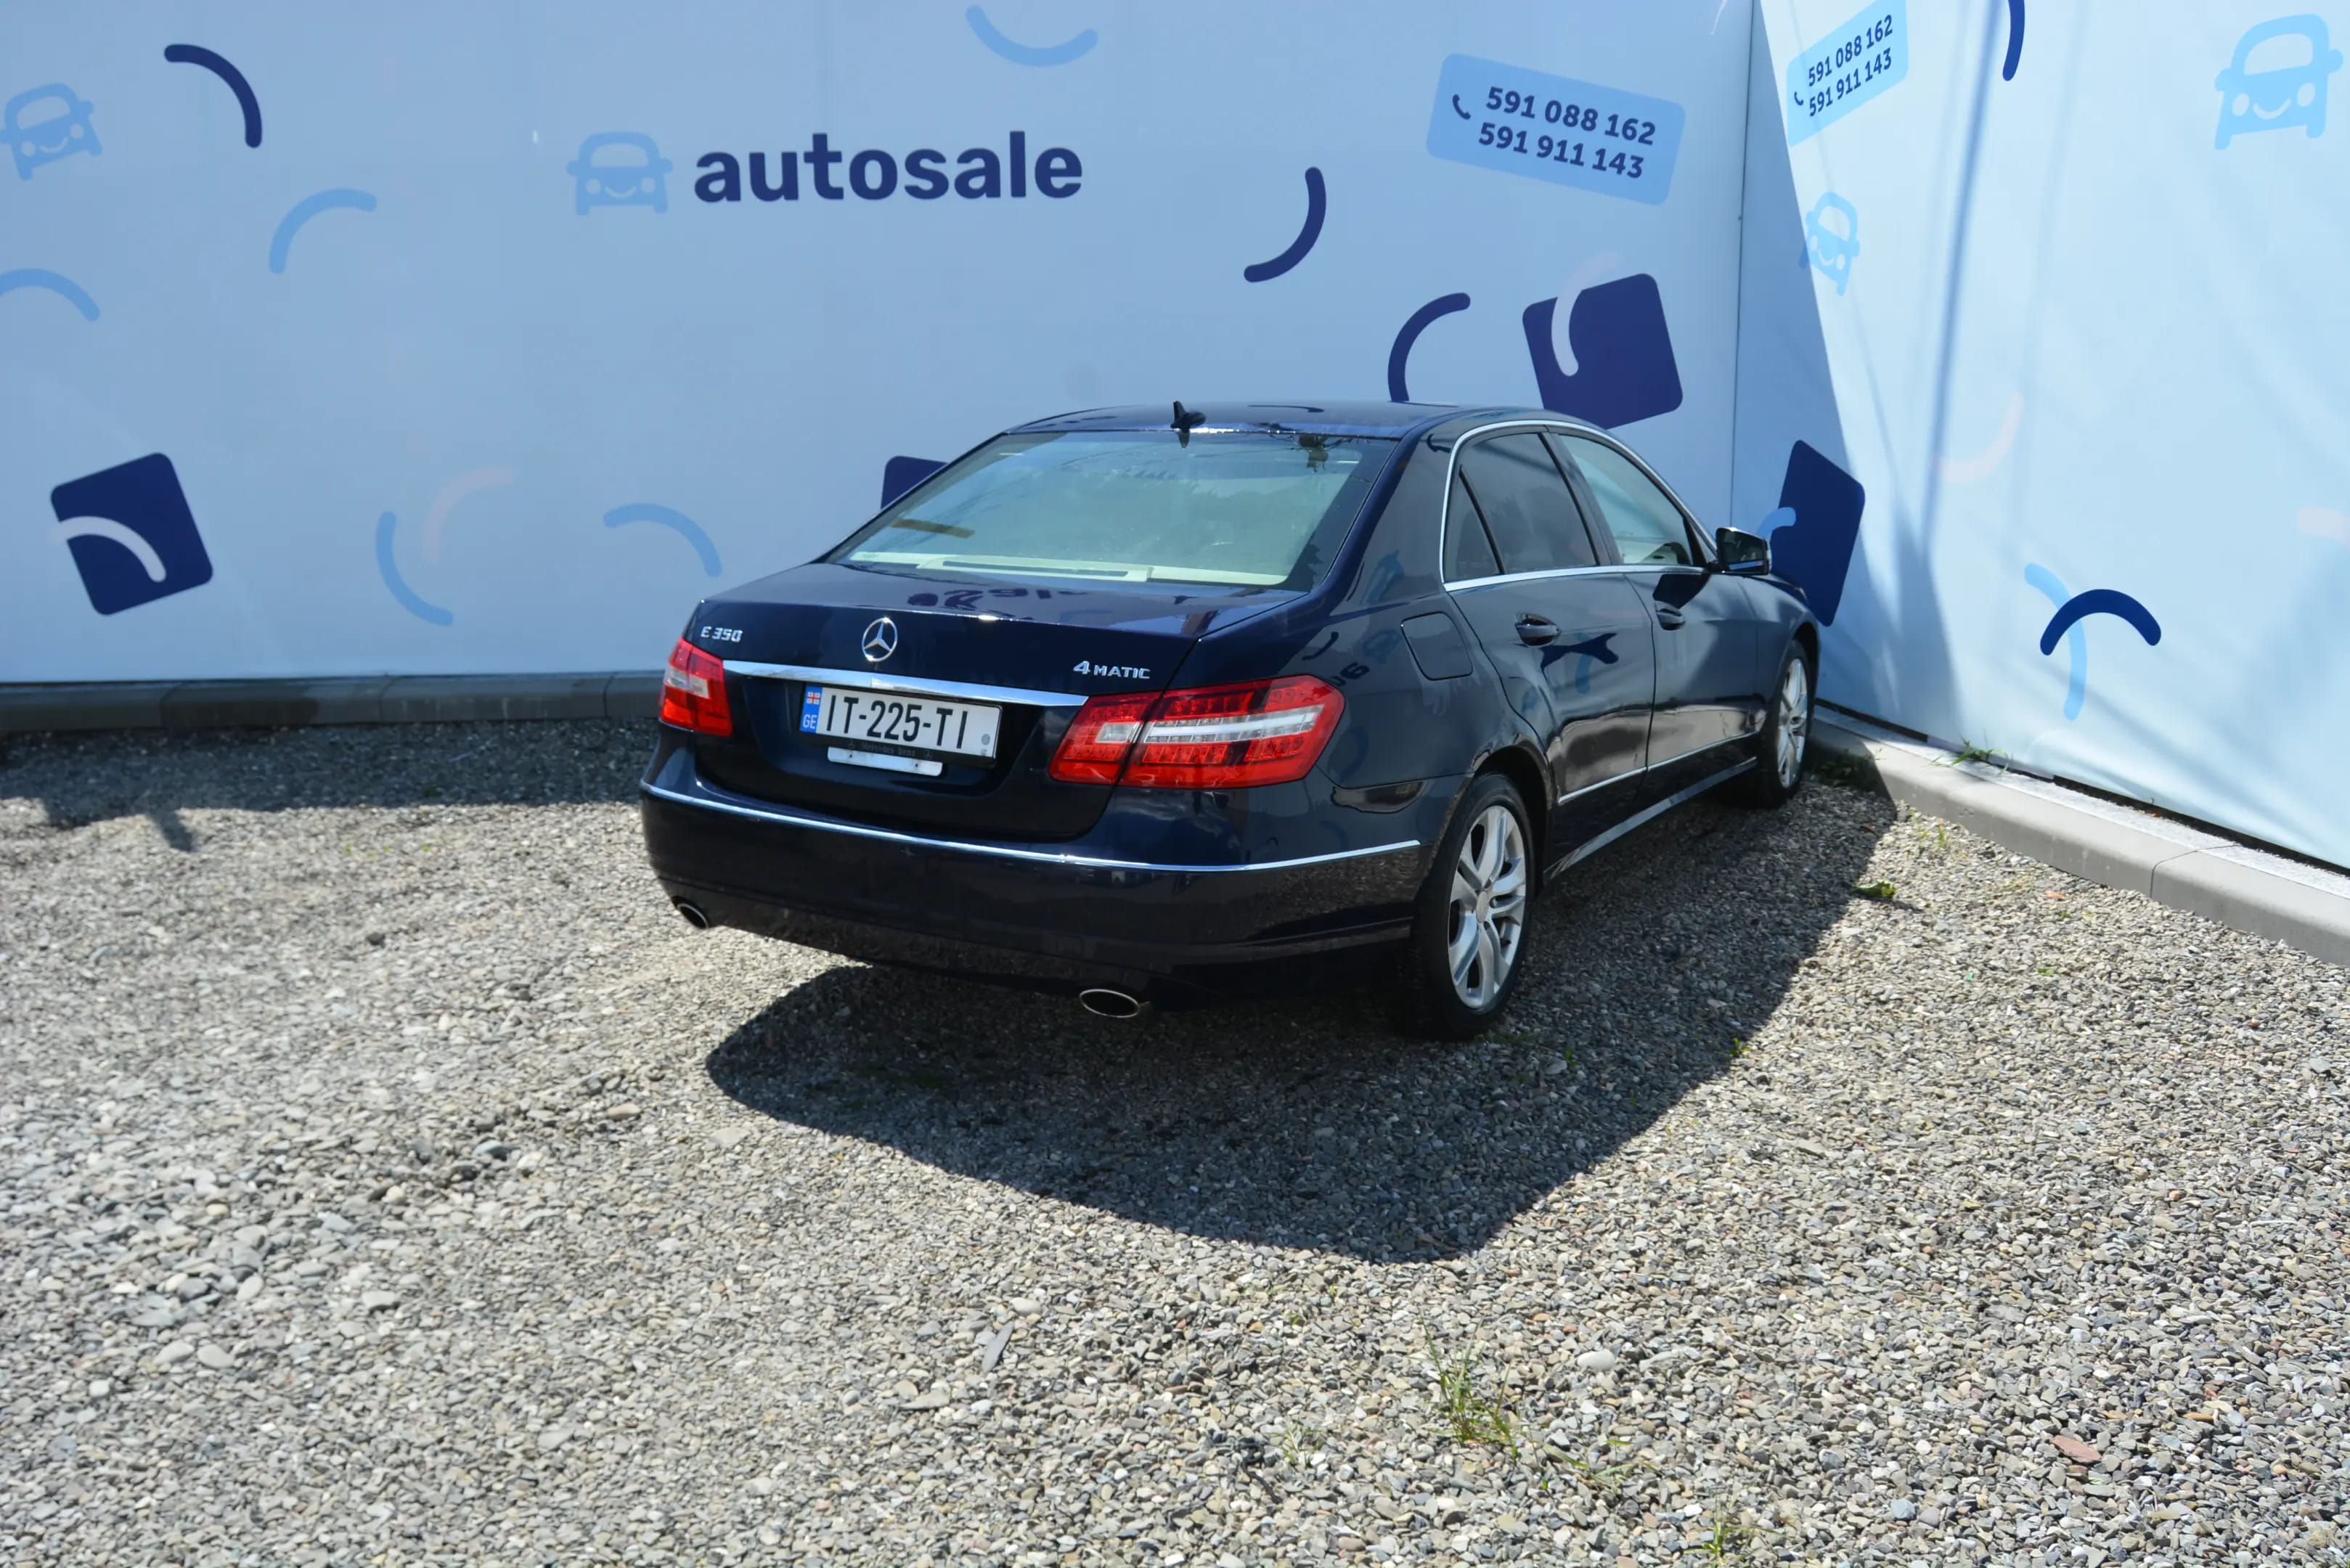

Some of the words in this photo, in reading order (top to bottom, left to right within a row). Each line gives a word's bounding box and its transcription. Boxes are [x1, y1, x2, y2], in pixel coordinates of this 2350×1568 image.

[1808, 56, 1832, 87] 591
[1835, 35, 1862, 68] 088
[1866, 15, 1893, 49] 162
[1809, 86, 1833, 117] 591
[1836, 68, 1861, 100] 911
[1864, 47, 1892, 83] 143
[1486, 86, 1535, 119] 591
[1544, 99, 1599, 131] 088
[1604, 113, 1656, 145] 162
[694, 131, 1082, 203] autosale
[1478, 122, 1527, 154] 591
[1536, 135, 1584, 166] 911
[1592, 148, 1644, 179] 143
[700, 626, 711, 638] E
[711, 627, 743, 642] 350
[802, 714, 817, 730] GE
[826, 695, 968, 748] IT-225-TI
